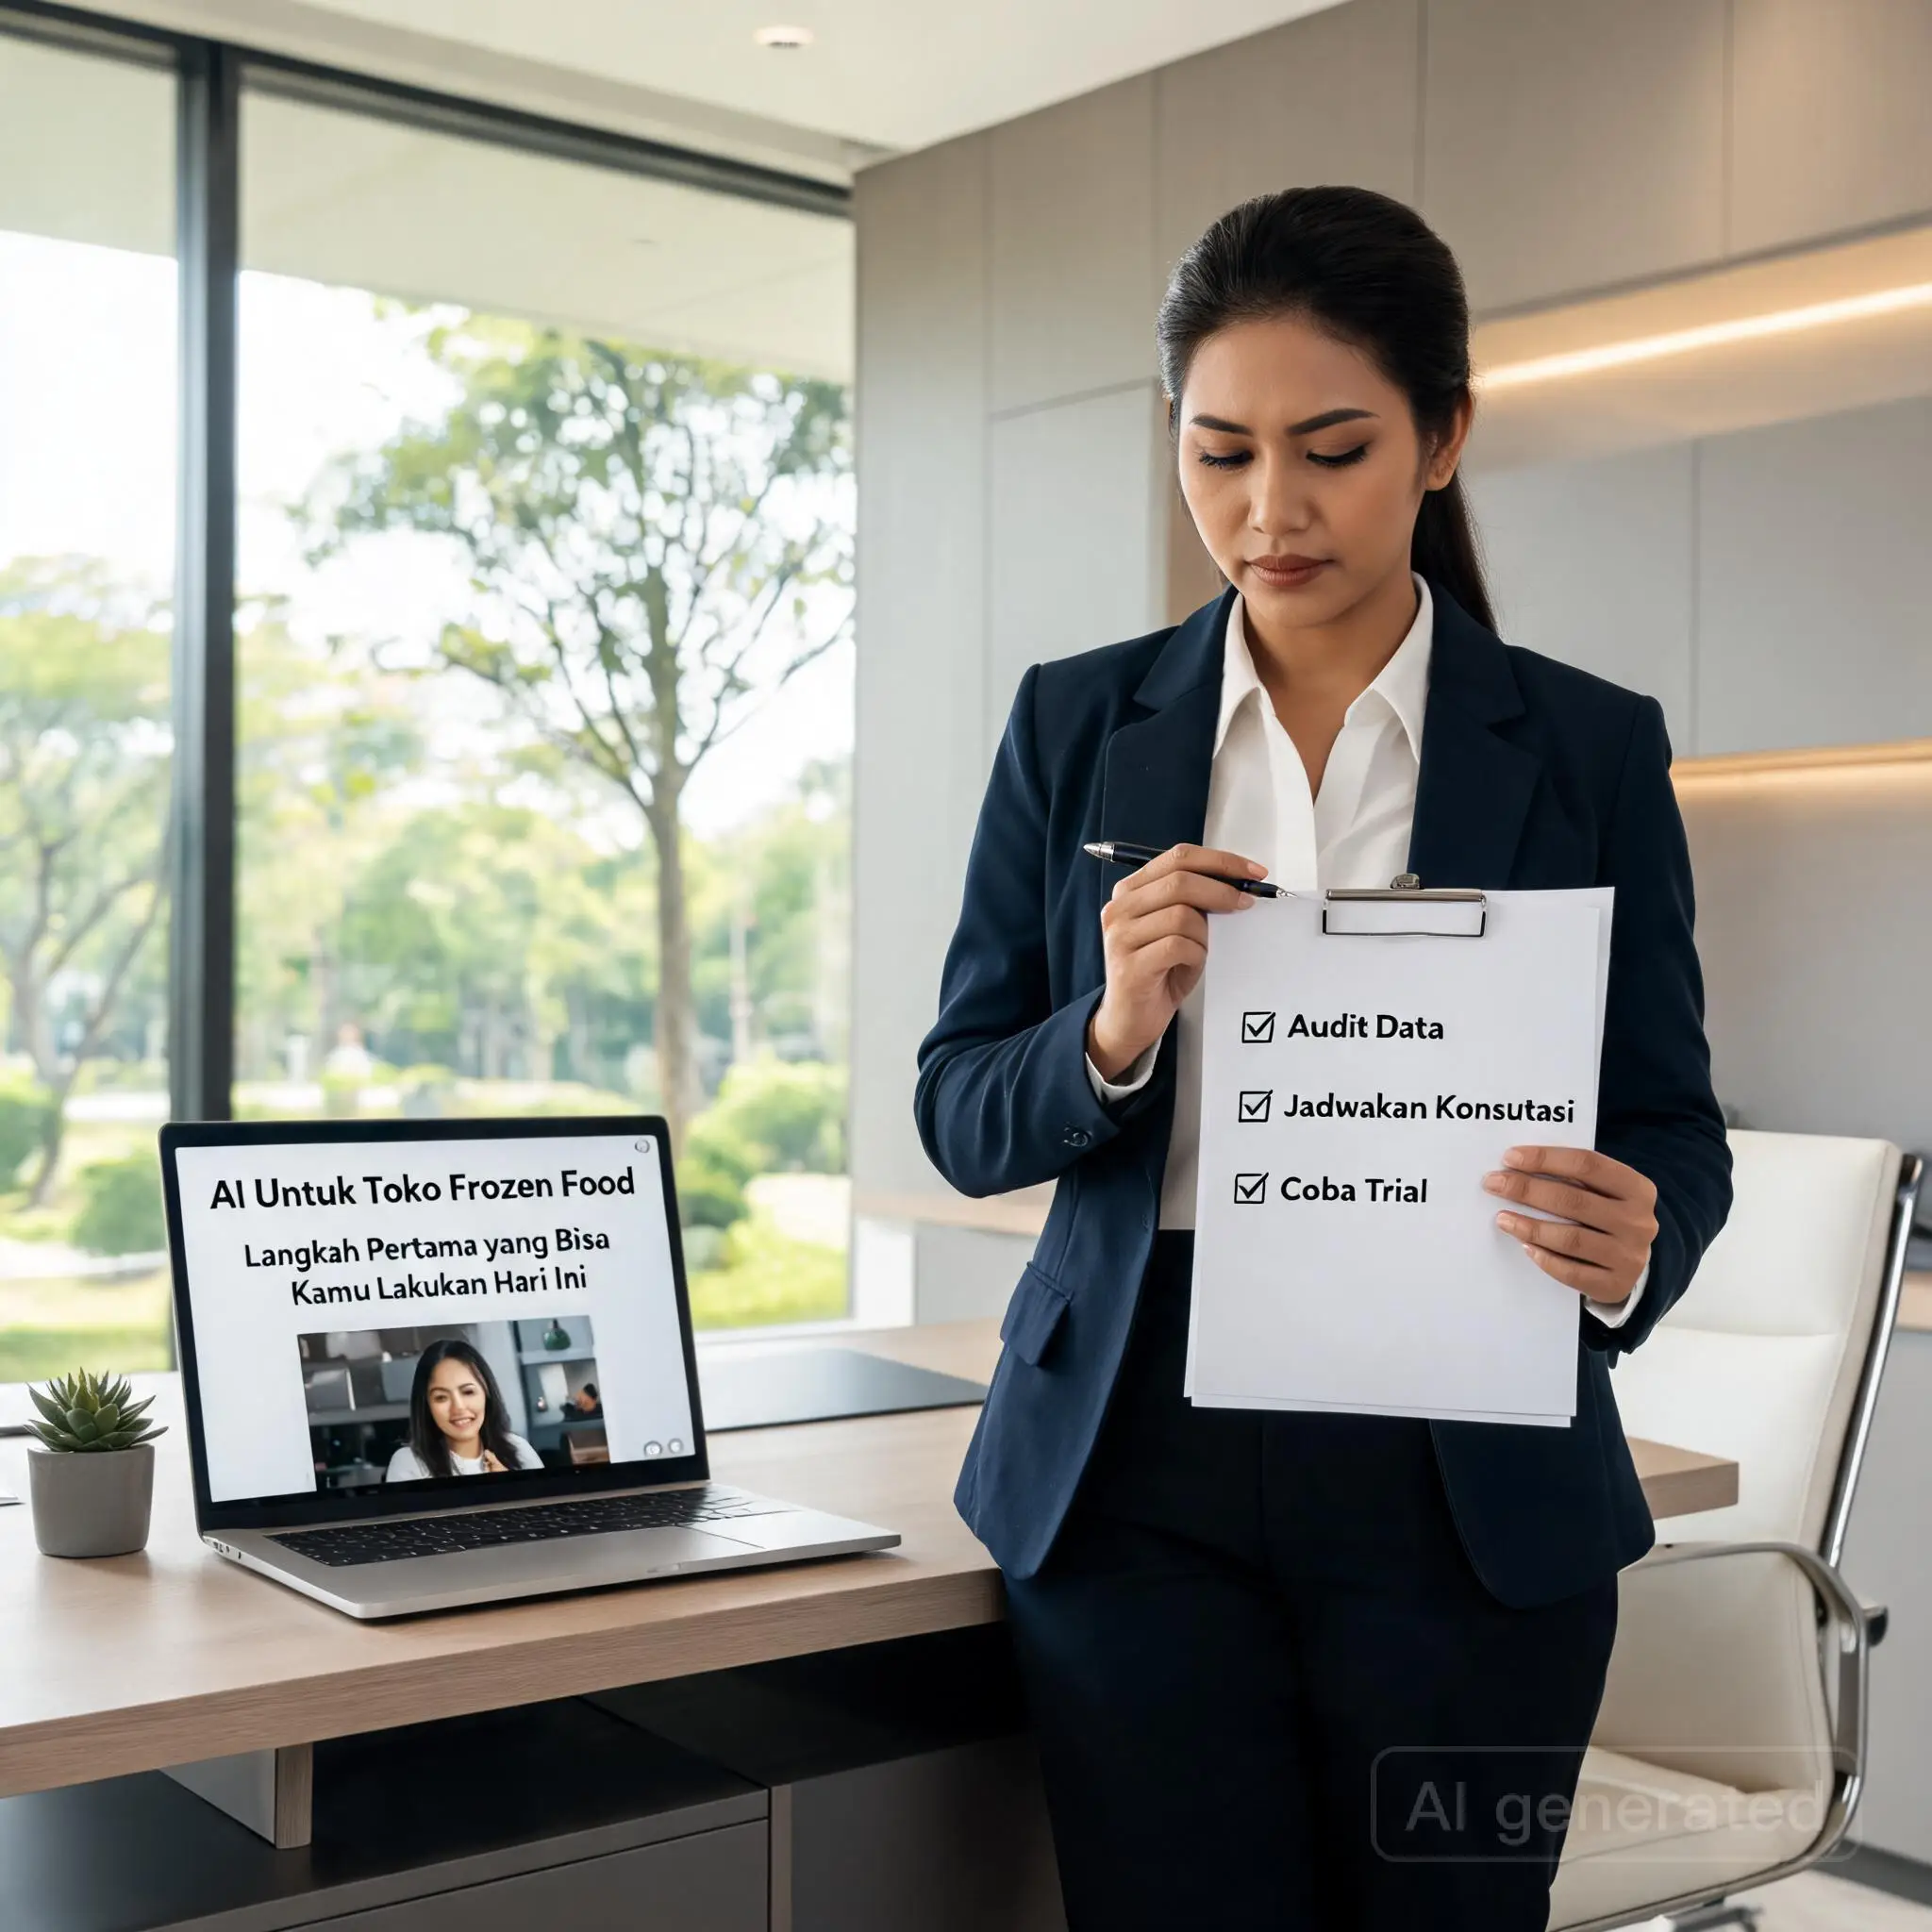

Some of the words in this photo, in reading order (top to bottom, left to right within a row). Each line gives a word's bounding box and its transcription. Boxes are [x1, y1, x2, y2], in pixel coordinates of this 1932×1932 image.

[1287, 1012, 1369, 1039] Audit
[1375, 1014, 1444, 1041] Data
[1283, 1091, 1427, 1120] Jadwakan
[1436, 1094, 1574, 1124] Konsutasi
[209, 1179, 245, 1209] AI
[254, 1175, 357, 1208] Untuk
[362, 1173, 441, 1205] Toko
[449, 1173, 554, 1201] Frozen
[560, 1165, 635, 1197] Food
[1280, 1175, 1357, 1202] Coba
[1364, 1177, 1427, 1204] Trial
[244, 1238, 360, 1273] Langkah
[366, 1237, 478, 1261] Pertama
[483, 1236, 549, 1262] yang
[555, 1226, 610, 1252] Bisa
[291, 1279, 371, 1306] Kamu
[376, 1272, 488, 1300] Lakukan
[493, 1267, 548, 1294] Hari
[554, 1264, 587, 1291] Ini
